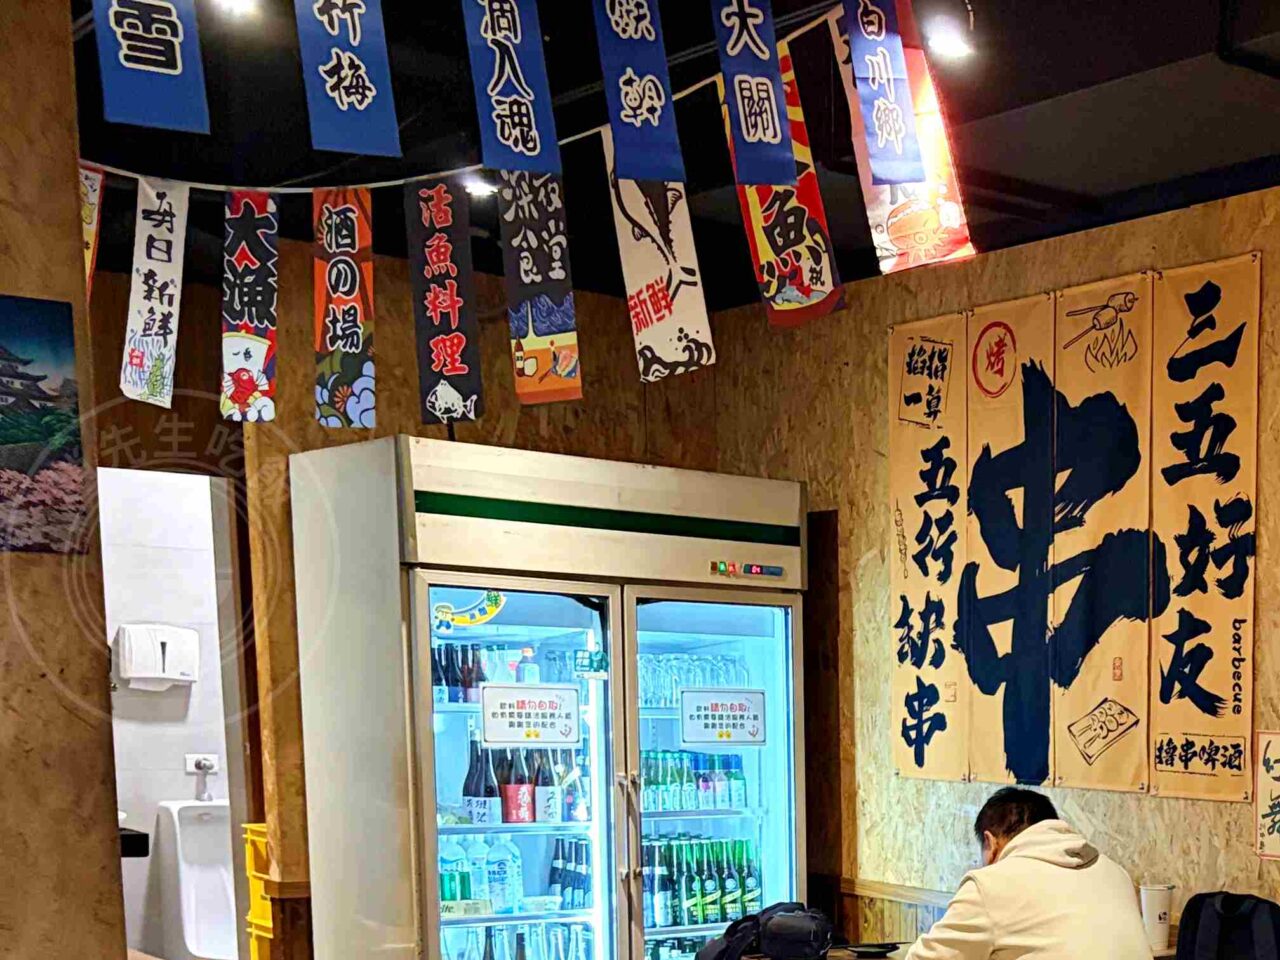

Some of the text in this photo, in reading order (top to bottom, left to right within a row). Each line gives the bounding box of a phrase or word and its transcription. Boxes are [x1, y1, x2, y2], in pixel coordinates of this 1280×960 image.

[321, 203, 363, 353] 酒の場
[418, 183, 470, 376] 活魚料理
[983, 333, 1012, 379] 烤
[951, 356, 1171, 786] 串
[1159, 280, 1256, 719] 三五好友
[1231, 617, 1246, 716] barbecue
